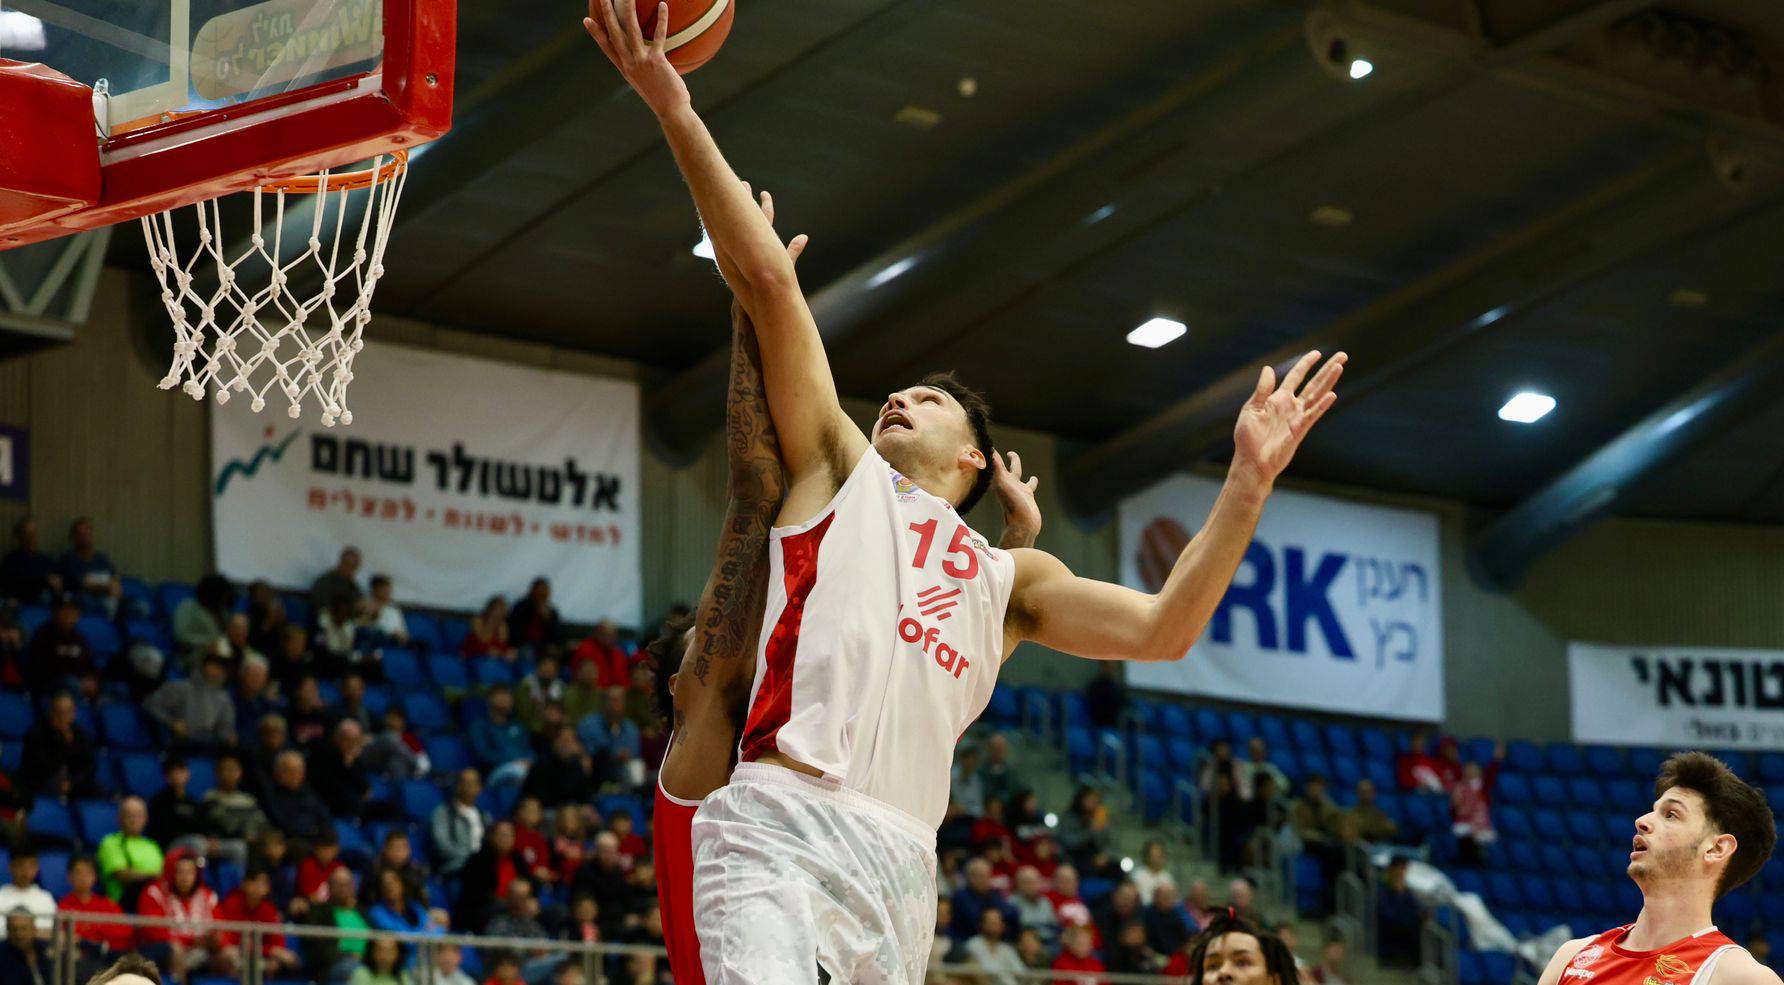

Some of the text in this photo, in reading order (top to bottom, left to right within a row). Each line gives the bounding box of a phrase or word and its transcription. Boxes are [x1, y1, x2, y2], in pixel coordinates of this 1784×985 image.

[310, 432, 621, 513] אלטשולר שחם
[909, 518, 979, 580] 15
[1354, 556, 1429, 606] רענן
[1210, 536, 1357, 662] RK
[898, 604, 970, 680] ofar
[1367, 616, 1420, 672] כץ
